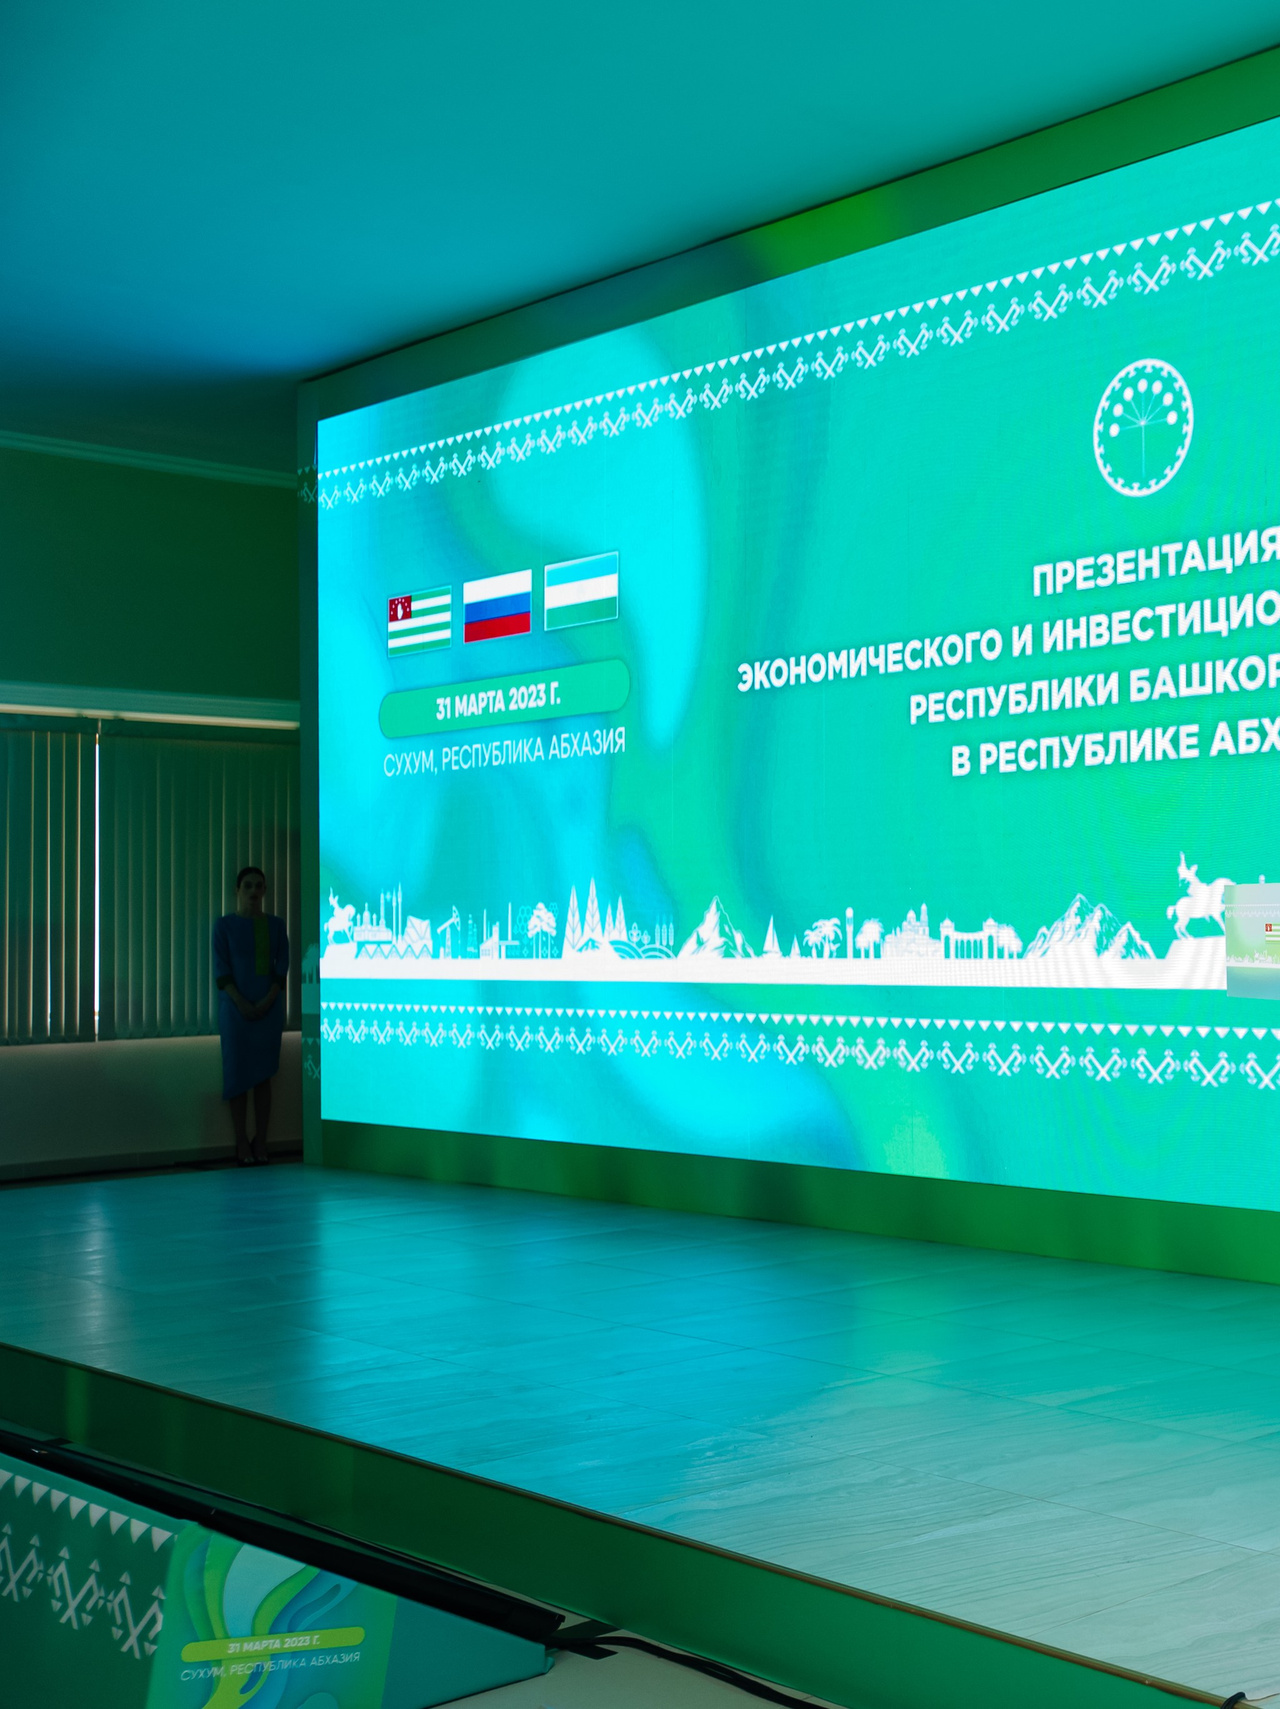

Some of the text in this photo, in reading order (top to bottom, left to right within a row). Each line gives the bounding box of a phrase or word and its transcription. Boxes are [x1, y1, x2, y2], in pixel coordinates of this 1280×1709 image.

[737, 628, 1003, 692] ЭКОНОМИЧЕСКОГО
[1012, 624, 1032, 657] И
[436, 681, 561, 720] 31 МАРТА 2023 Г.
[910, 671, 1119, 725] РЕСПУБЛИКИ
[383, 726, 626, 777] СУХУМ, РЕСПУБЛИКА АБХАЗИЯ
[952, 745, 971, 777] В
[979, 724, 1200, 775] РЕСПУБЛИКЕ
[180, 1652, 361, 1681] СУХУМ, РЕСПУБЛИКА АБХАЗИЯ
[227, 1635, 320, 1654] 31 МАРТА 2023 Г.
